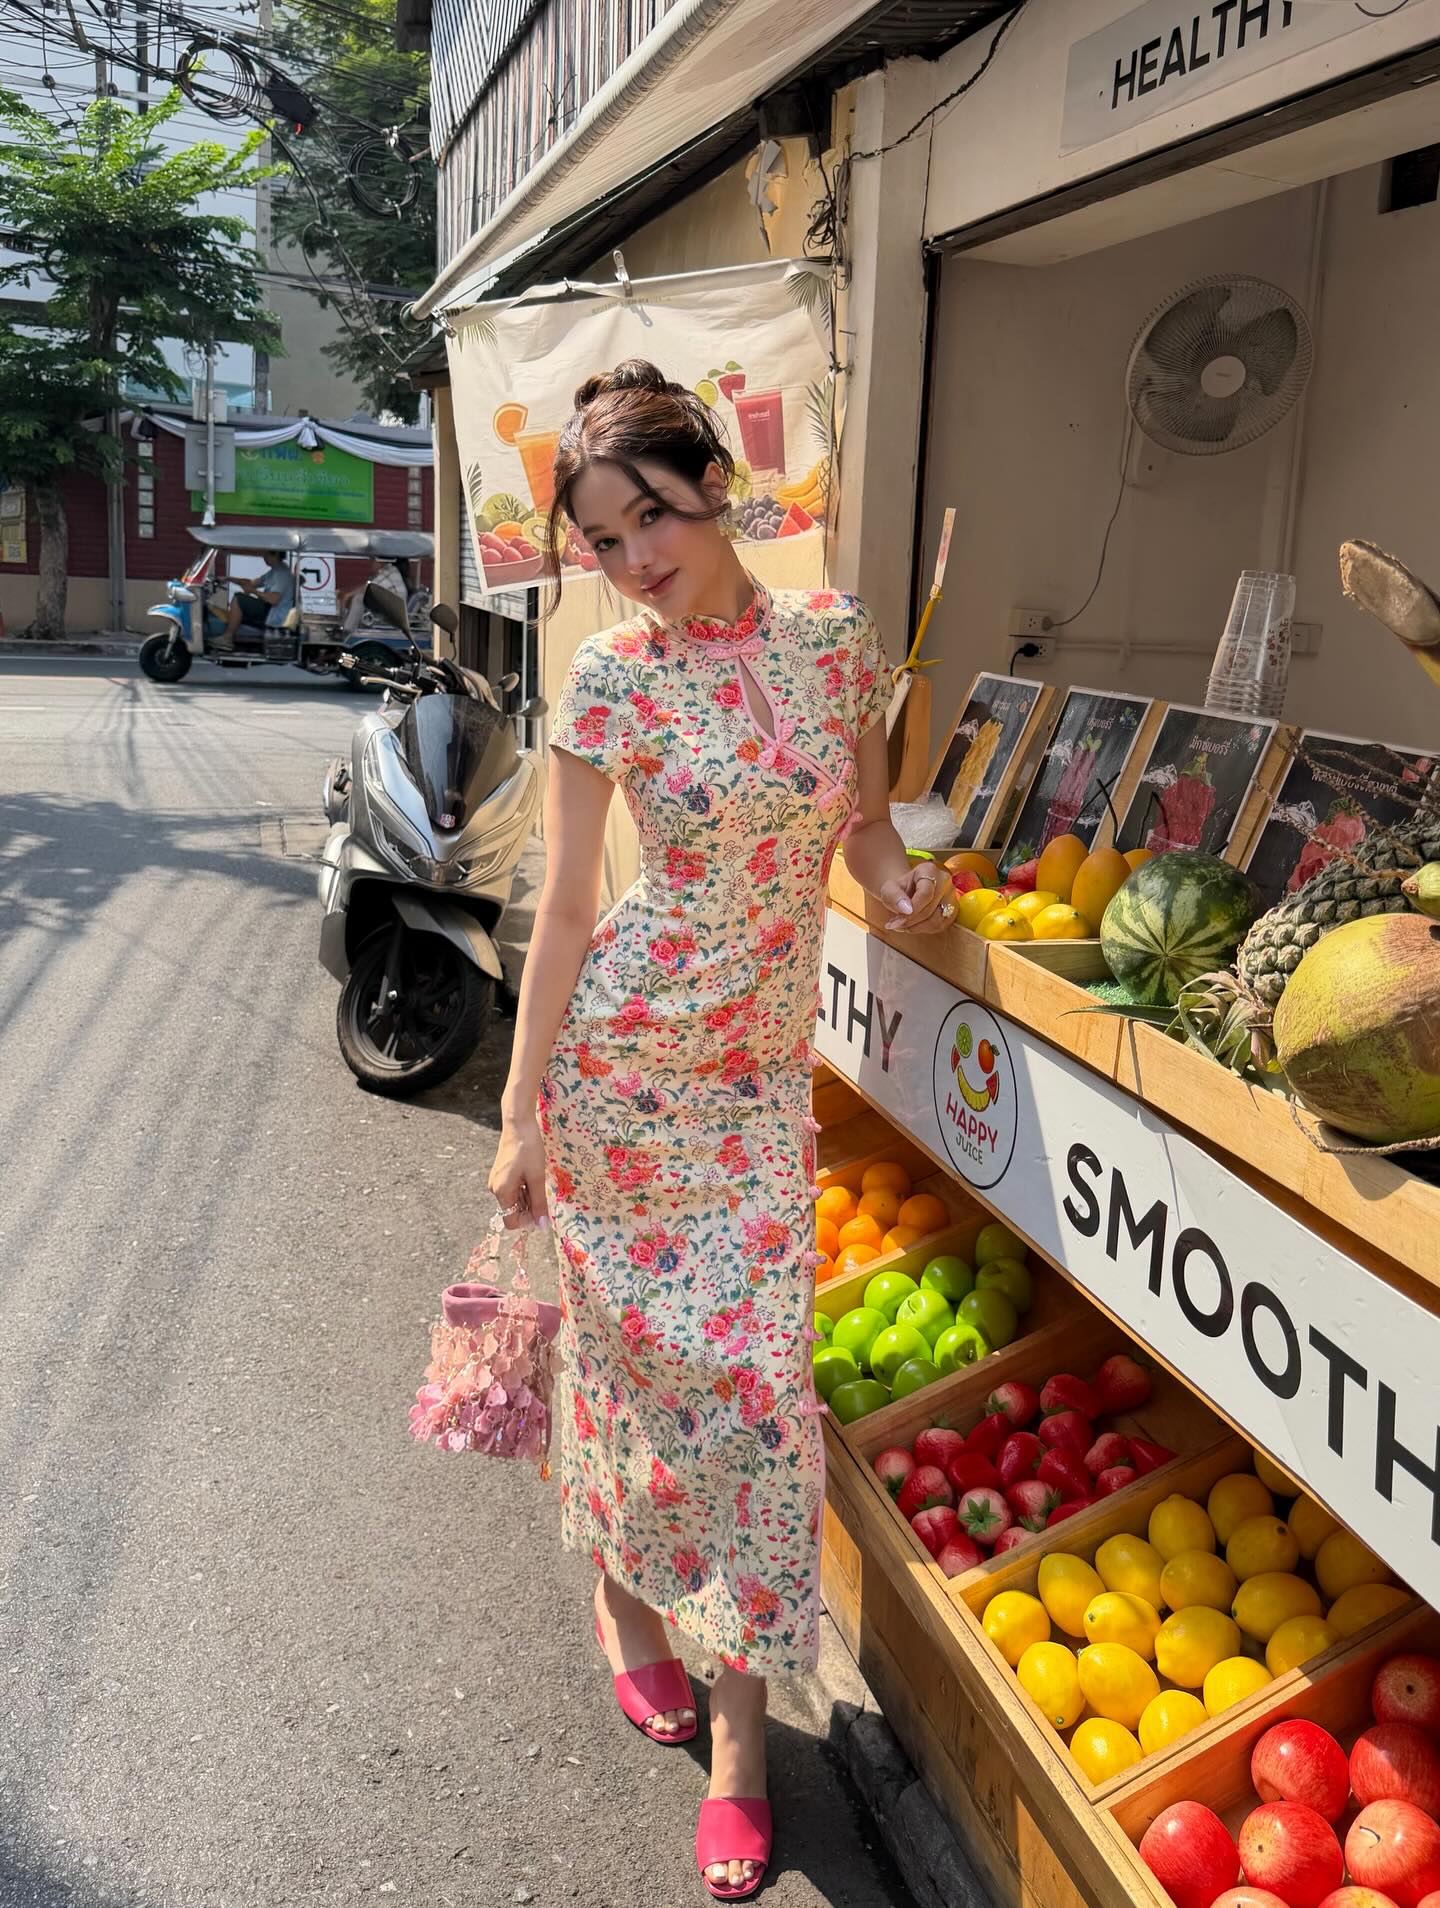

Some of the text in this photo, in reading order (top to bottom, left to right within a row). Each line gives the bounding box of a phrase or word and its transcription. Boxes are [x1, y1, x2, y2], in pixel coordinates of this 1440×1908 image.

[817, 962, 903, 1073] THY
[945, 1091, 999, 1153] HAPPY
[955, 1131, 984, 1165] JUICE
[1062, 1142, 1440, 1547] SMOOTH
